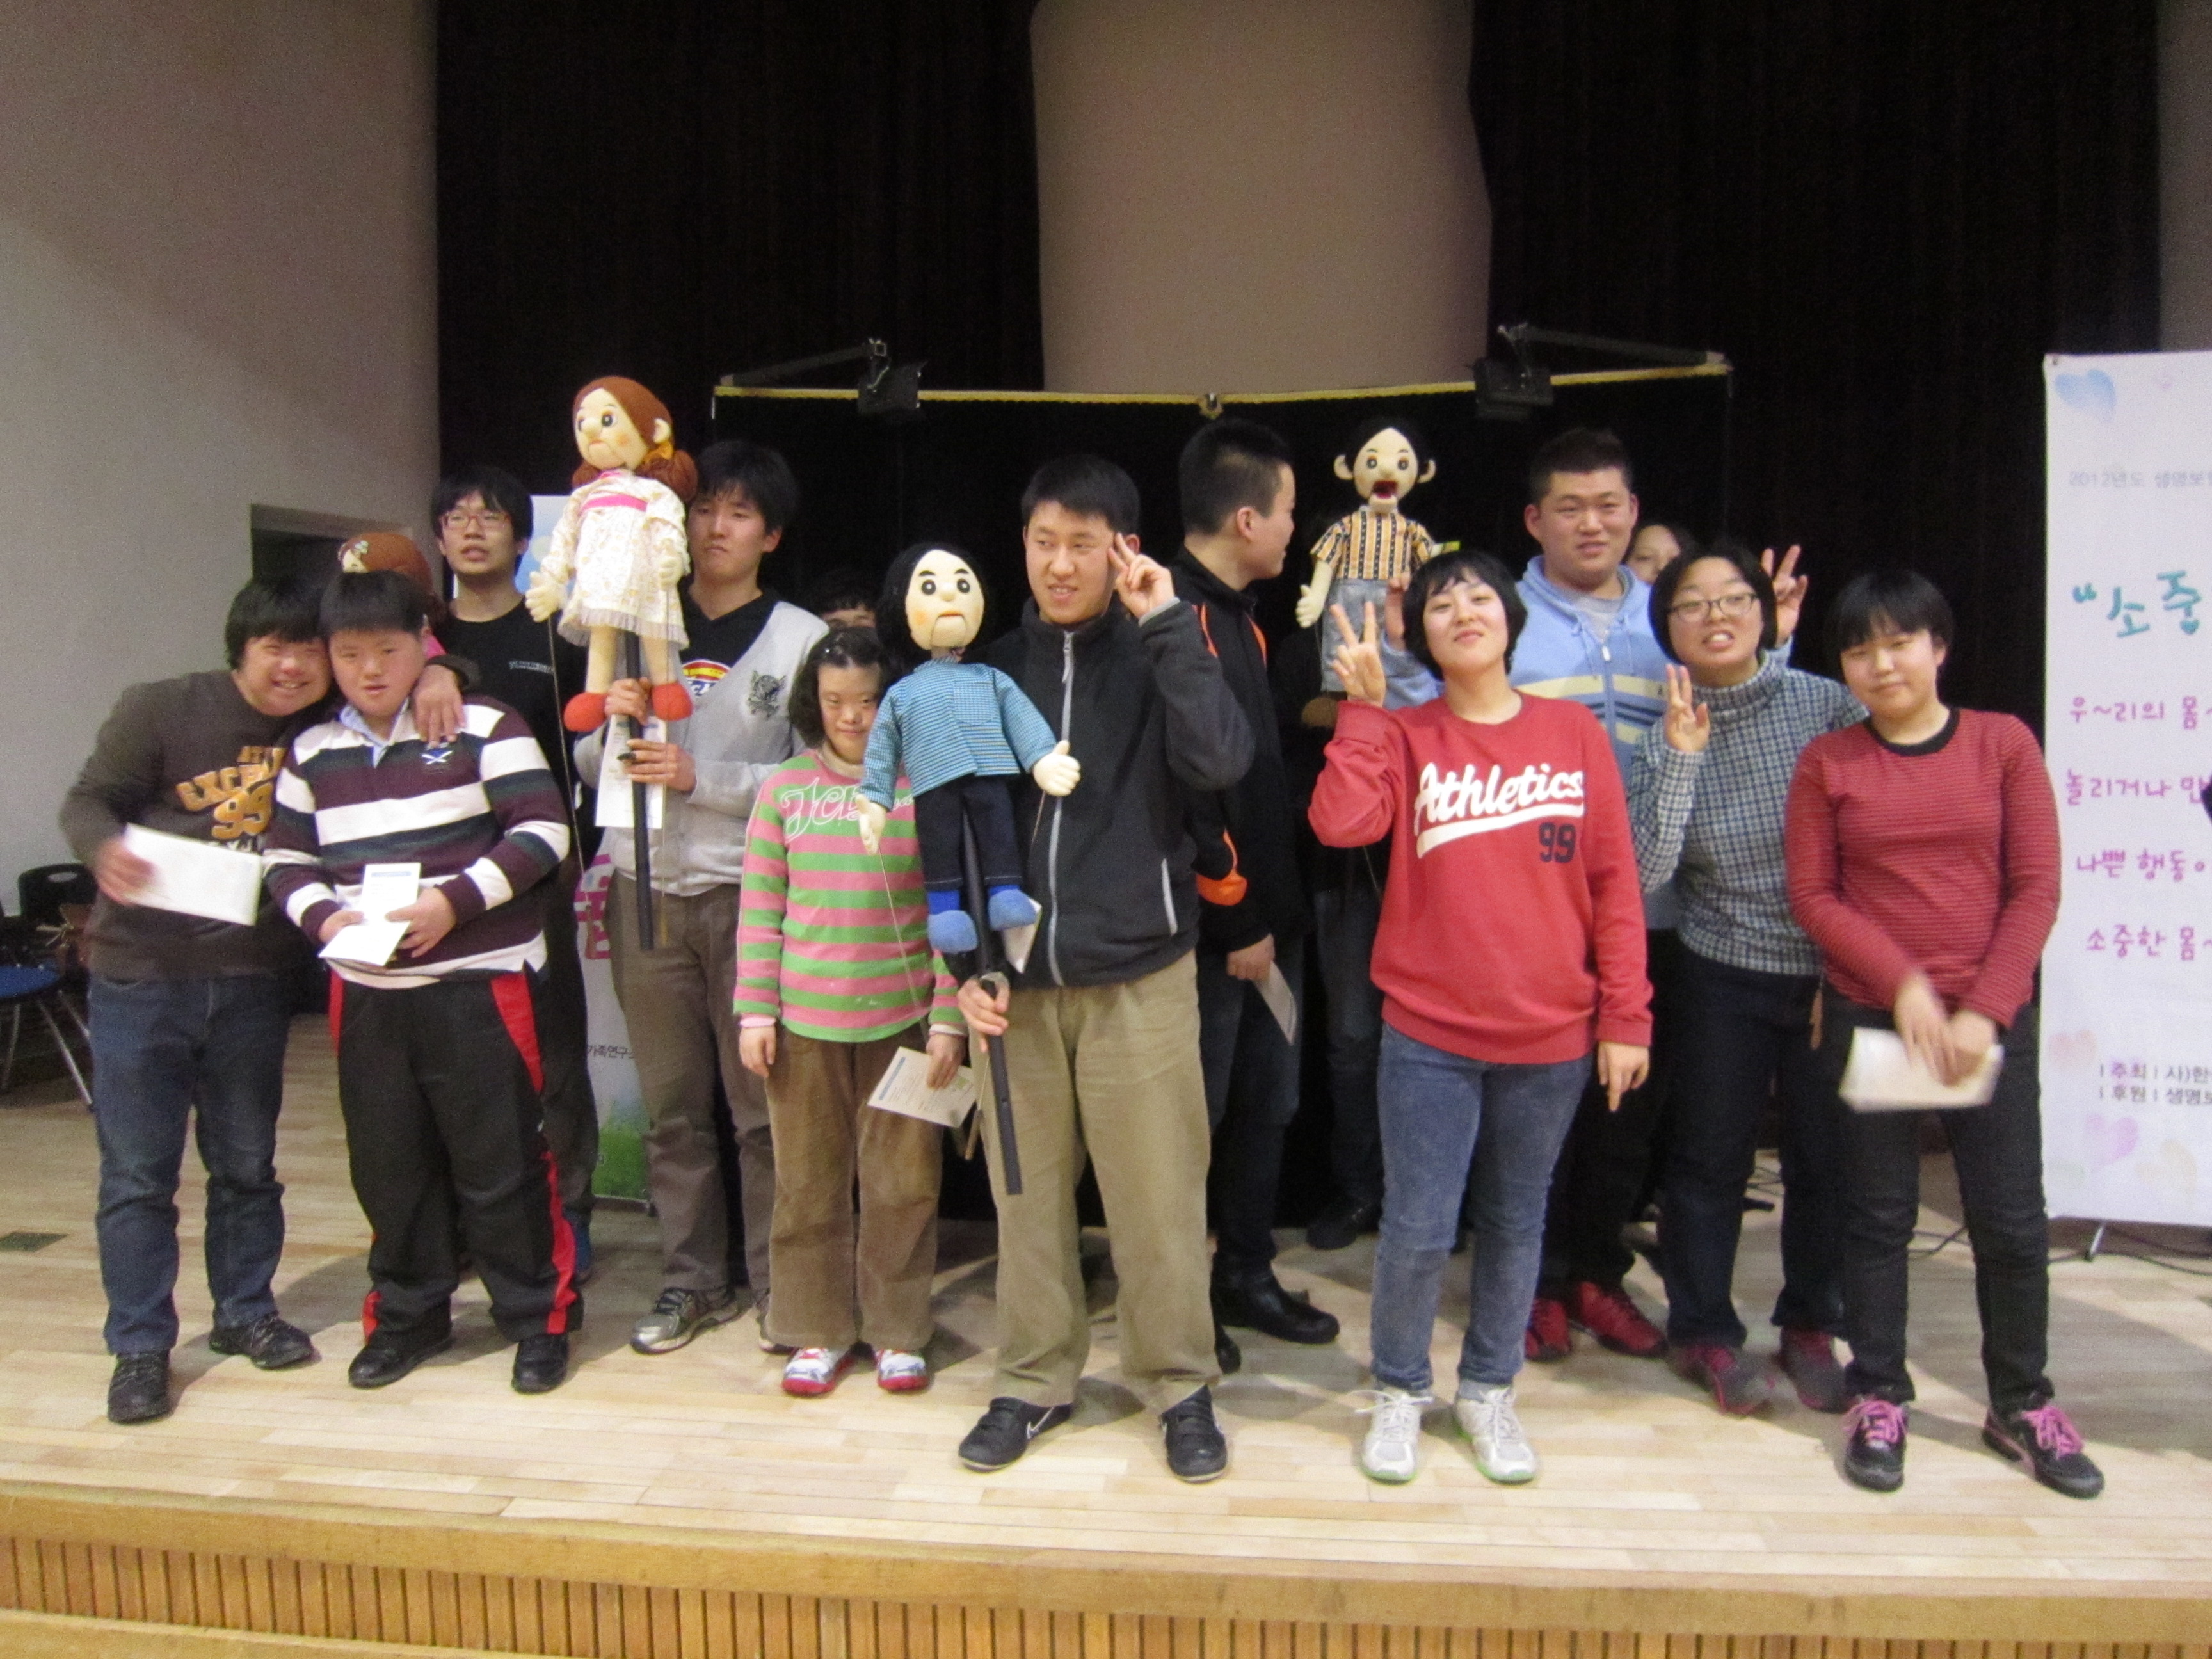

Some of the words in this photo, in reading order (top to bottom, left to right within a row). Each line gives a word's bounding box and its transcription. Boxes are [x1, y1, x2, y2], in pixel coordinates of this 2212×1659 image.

[1414, 762, 1584, 836] Athletics
[1539, 822, 1576, 863] 99
[2085, 924, 2167, 958] 소중한
